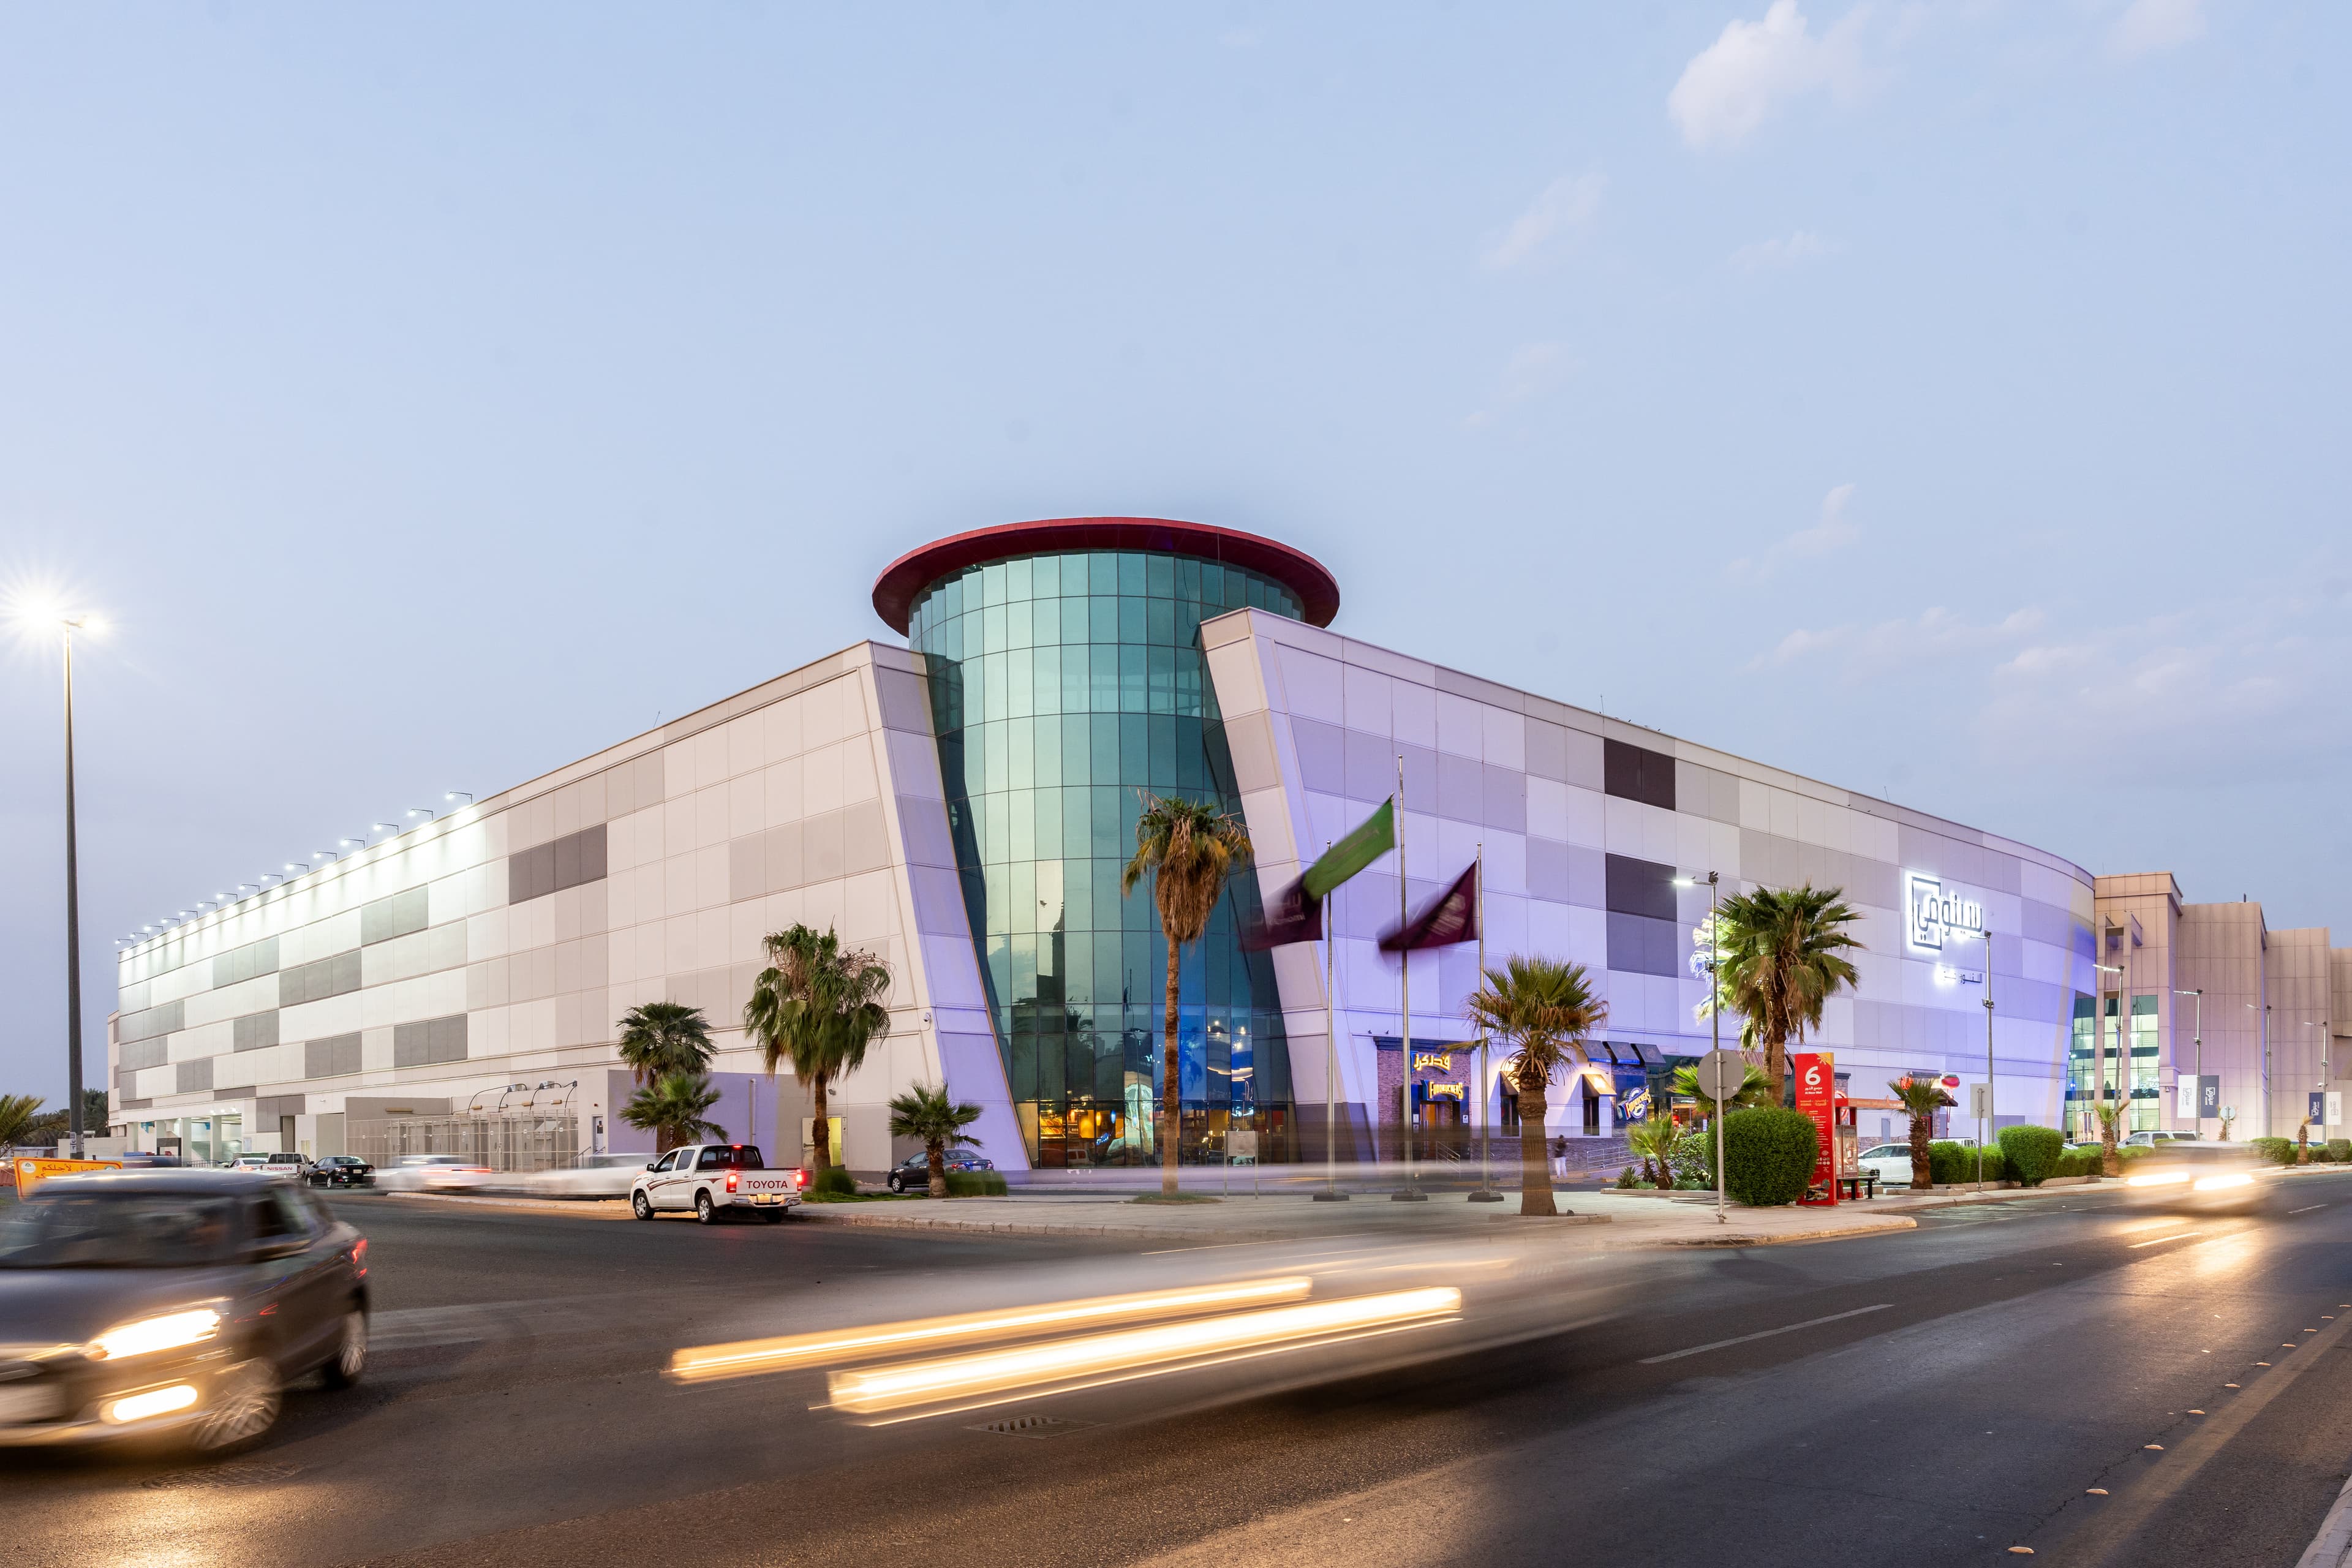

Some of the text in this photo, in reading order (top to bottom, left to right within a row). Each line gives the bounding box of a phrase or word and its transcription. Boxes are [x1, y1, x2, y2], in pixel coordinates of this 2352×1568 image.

[1917, 894, 1983, 942] سينومي
[1805, 1066, 1821, 1085] 6
[746, 1180, 788, 1189] TOYOTA
